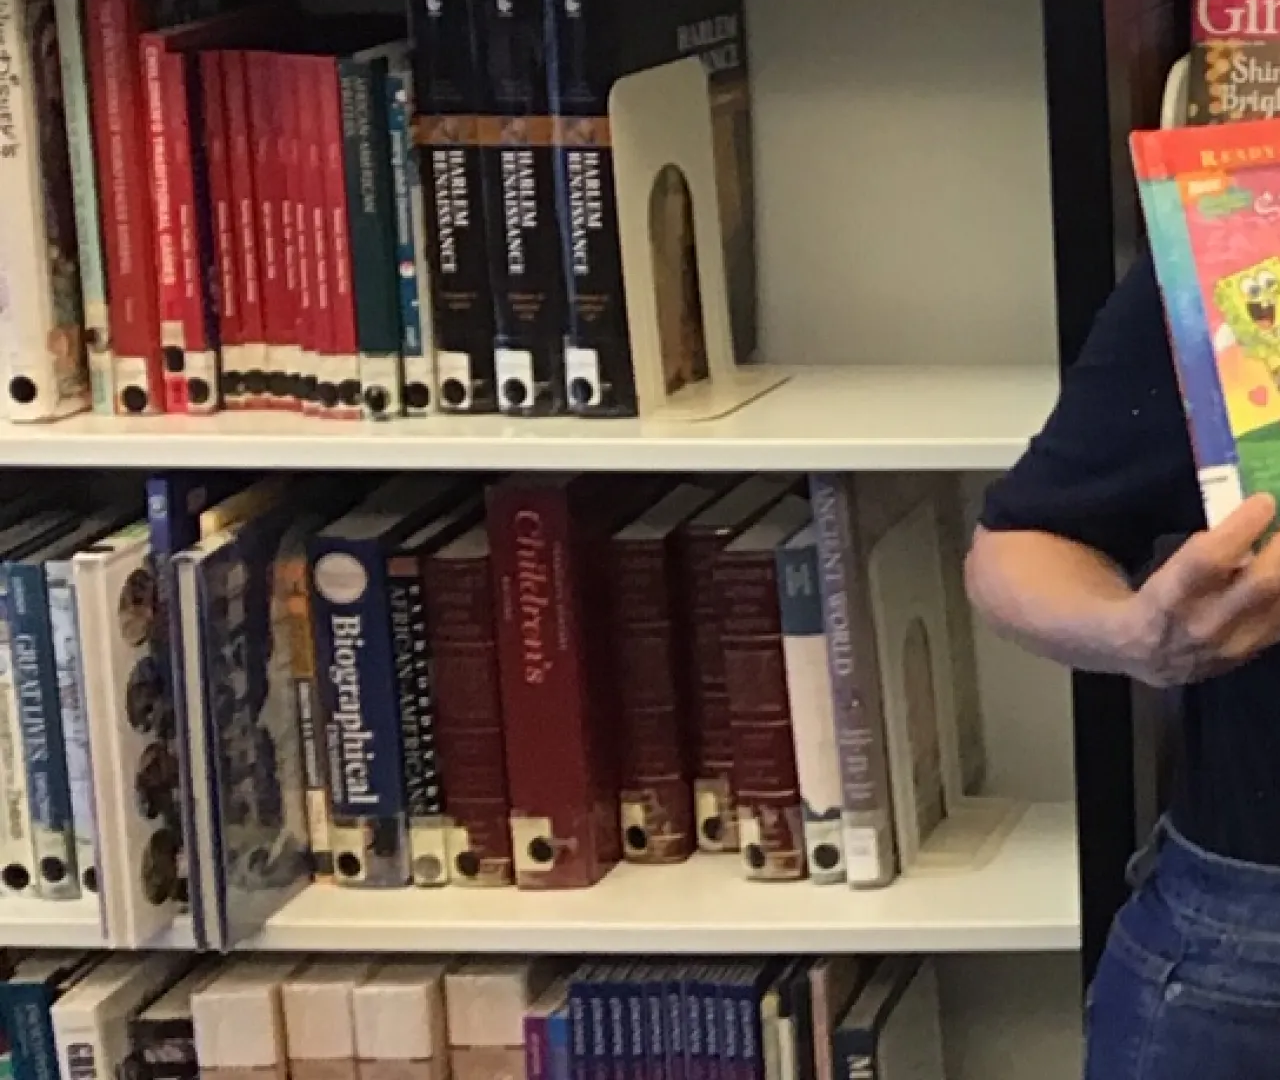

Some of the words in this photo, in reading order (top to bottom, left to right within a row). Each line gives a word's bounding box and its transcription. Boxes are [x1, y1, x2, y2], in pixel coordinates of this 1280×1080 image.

[152, 135, 174, 231] TRADITIONAL
[433, 151, 456, 274] RENAISSANCE
[450, 150, 469, 228] HARLEM
[501, 151, 524, 275] RENAISSANCE
[518, 150, 537, 228] HARLEM
[568, 152, 588, 277] RENAISSANCE
[584, 152, 602, 230] HARLEM
[159, 234, 177, 286] GAMES
[817, 483, 844, 583] ANCIENT
[513, 509, 555, 685] Children's
[825, 591, 859, 677] WORLD
[331, 614, 380, 804] Biographical
